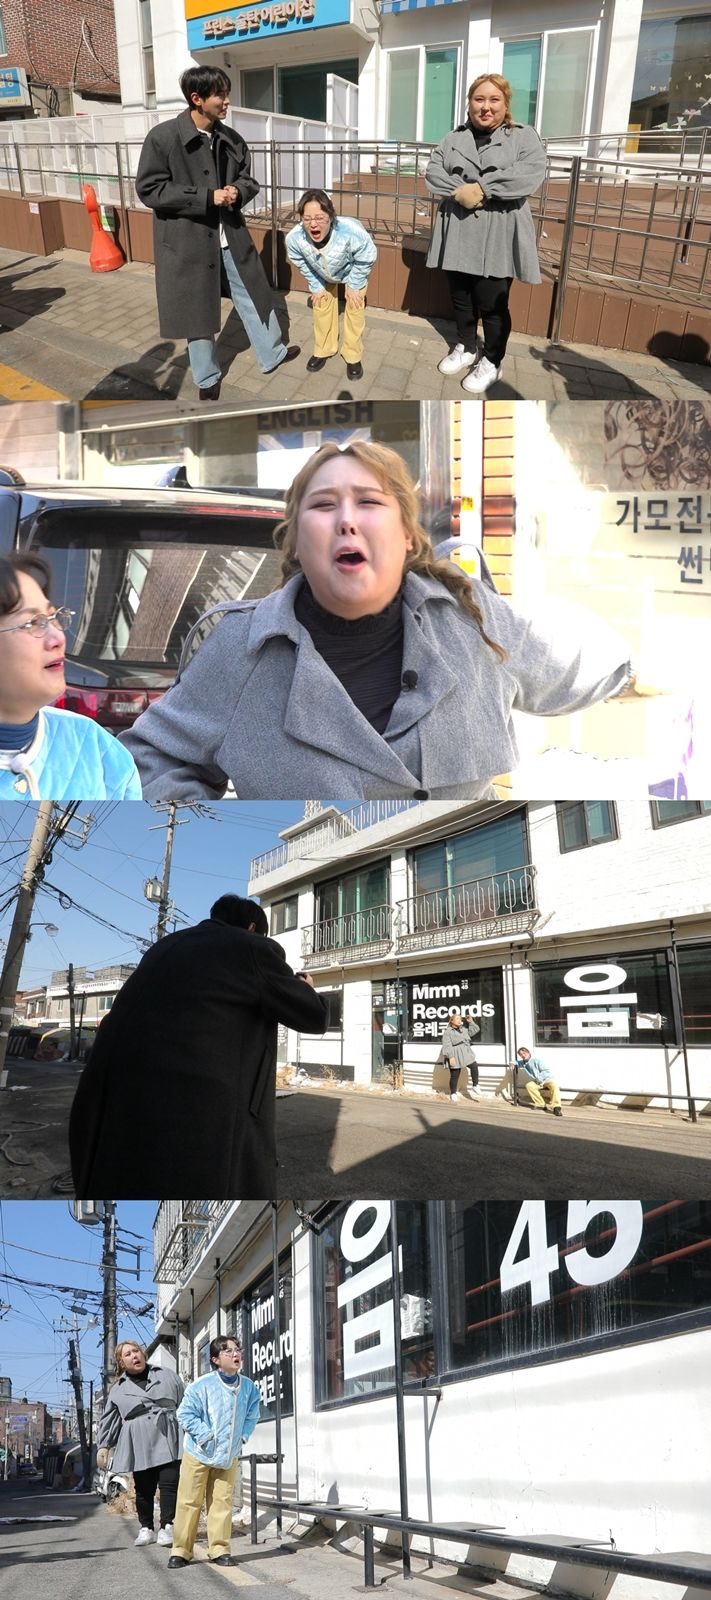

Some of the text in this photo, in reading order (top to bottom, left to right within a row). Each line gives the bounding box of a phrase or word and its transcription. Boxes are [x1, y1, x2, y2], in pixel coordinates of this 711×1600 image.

[257, 401, 374, 430] ENGLISH
[615, 495, 711, 533] 가모전
[677, 545, 711, 584] 썬
[412, 984, 461, 1000] Mmm
[412, 1000, 495, 1019] Records
[559, 963, 638, 1038] 음
[500, 1200, 643, 1306] 45
[337, 1200, 403, 1381] 음
